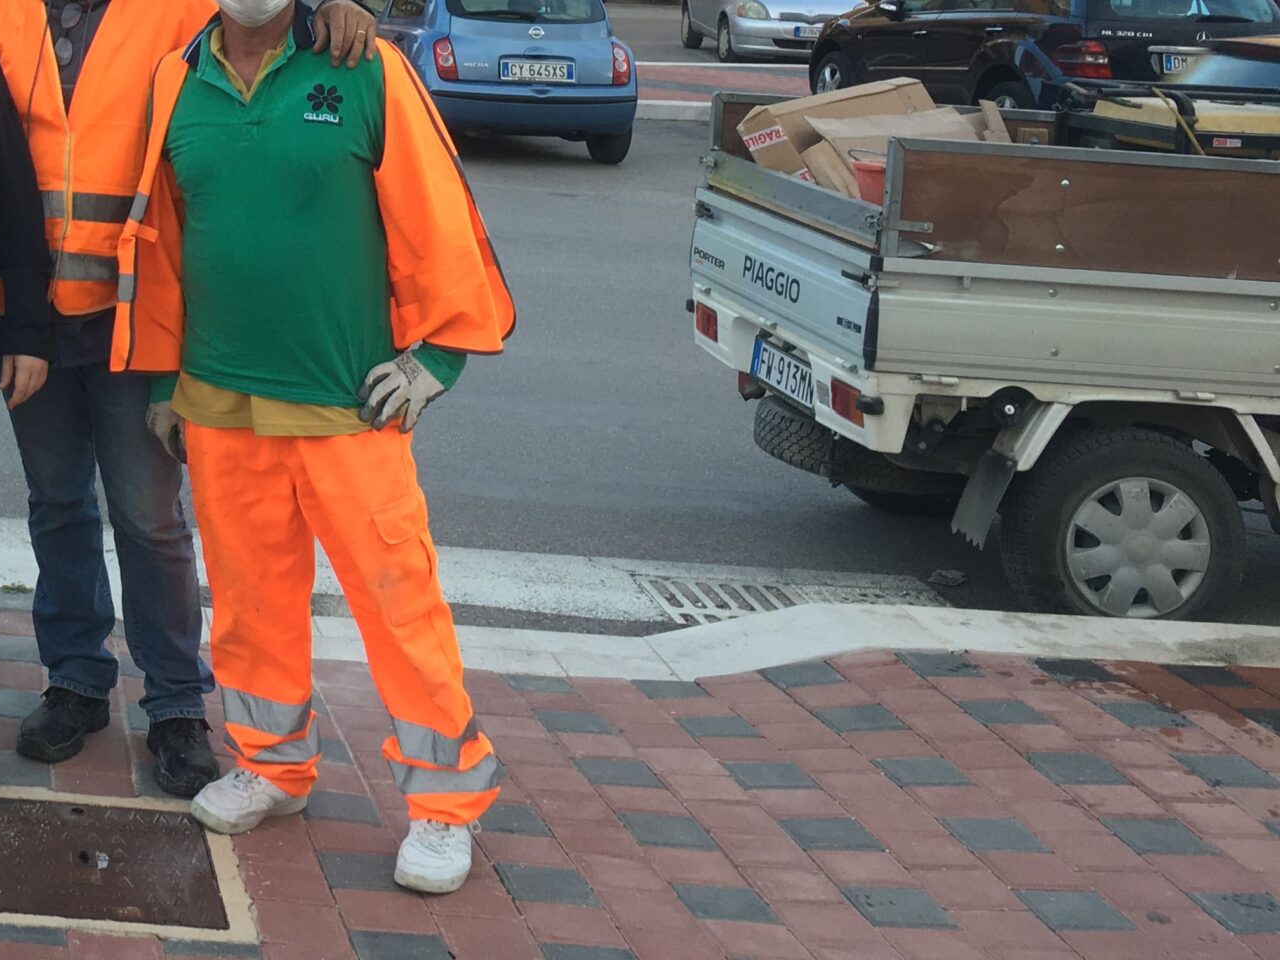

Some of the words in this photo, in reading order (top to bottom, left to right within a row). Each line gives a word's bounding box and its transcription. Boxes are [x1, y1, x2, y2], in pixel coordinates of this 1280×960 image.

[510, 63, 524, 78] CY
[528, 64, 566, 78] 645XS
[693, 246, 726, 271] PORTER
[742, 255, 801, 304] PIAGGIO
[776, 356, 814, 405] 913MN
